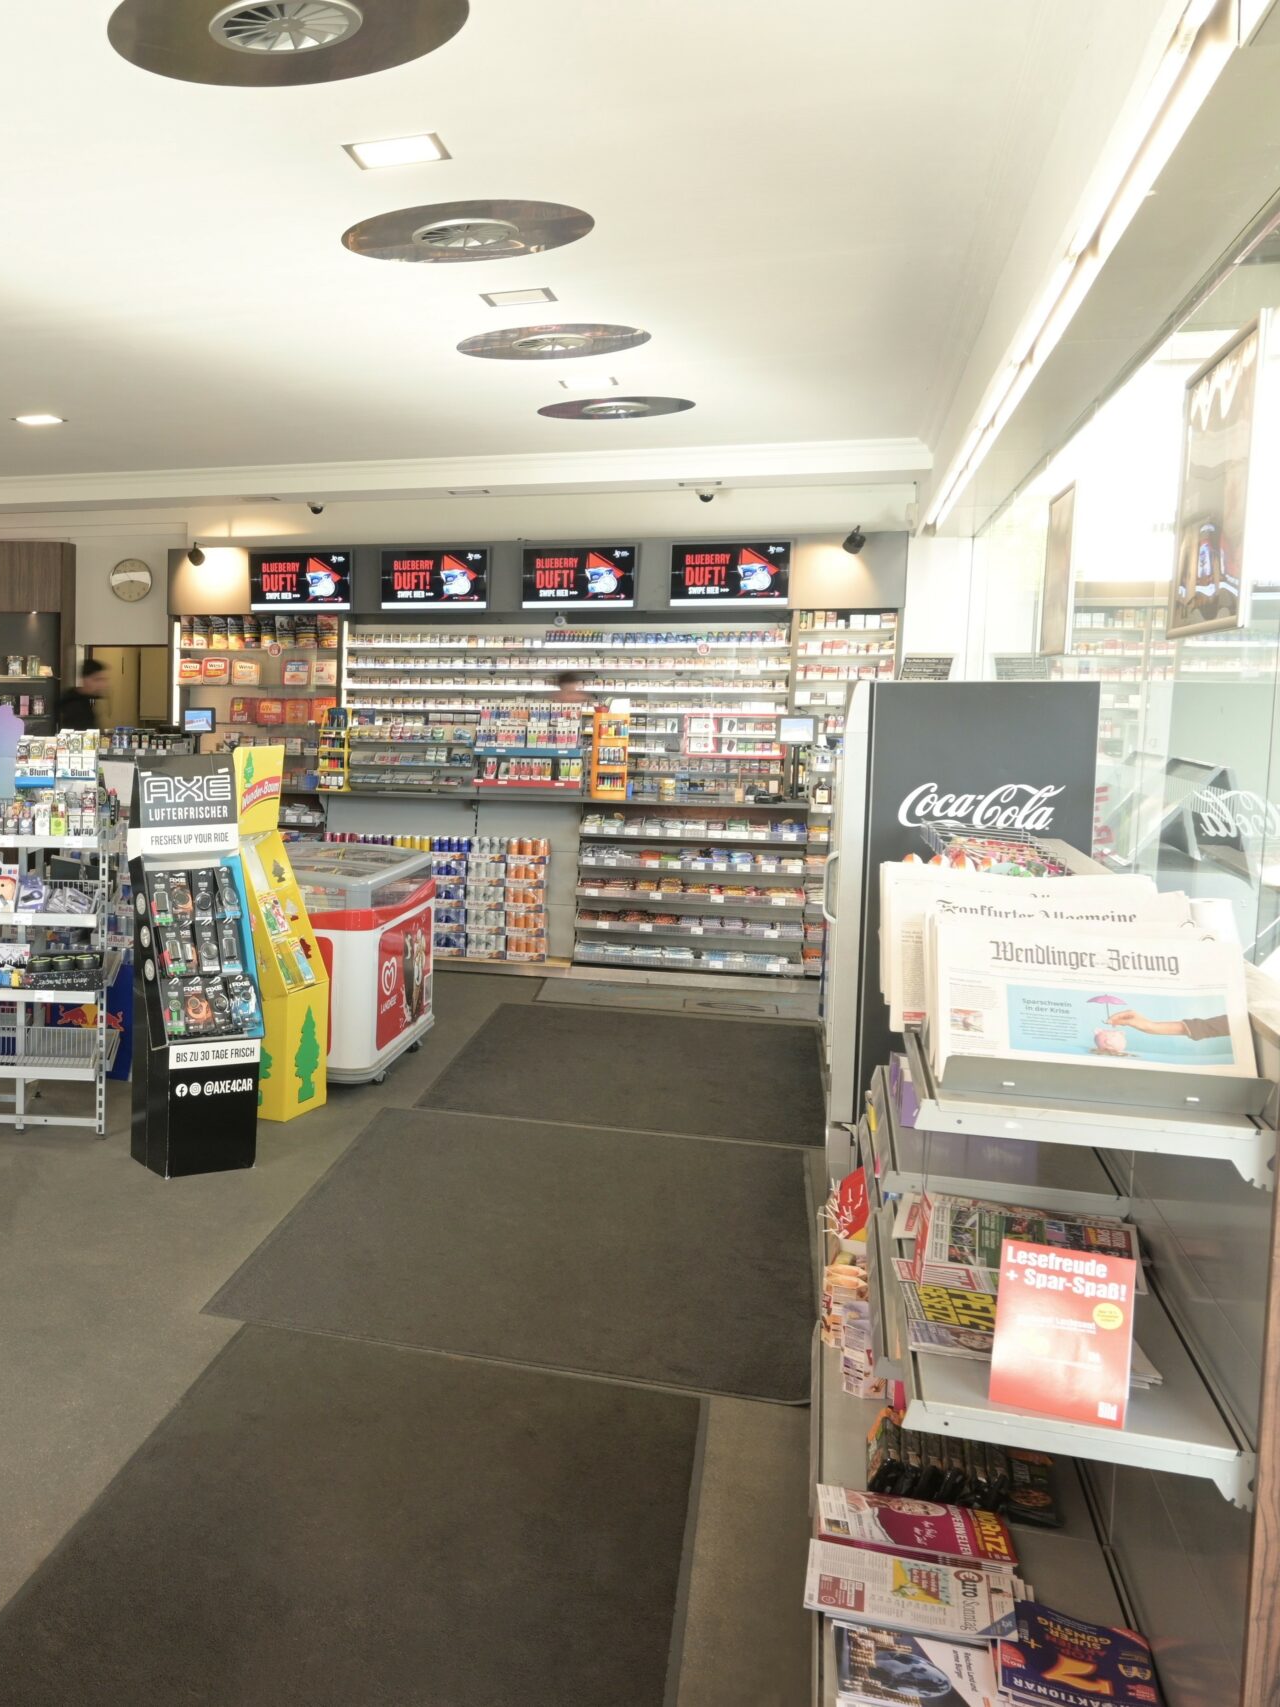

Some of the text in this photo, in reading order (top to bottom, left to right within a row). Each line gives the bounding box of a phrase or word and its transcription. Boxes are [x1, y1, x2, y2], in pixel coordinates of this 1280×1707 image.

[262, 562, 300, 573] BLUEBERRY
[393, 559, 434, 570] BLUEBERRY
[535, 557, 578, 569] BLUEBERRY
[685, 553, 731, 565] BLUEBERRY
[262, 574, 297, 592] DUFT!
[393, 571, 430, 590] DUFT!
[536, 569, 575, 589] DUFT!
[685, 565, 726, 586] DUFT!
[30, 768, 48, 776] Blunt
[148, 805, 228, 822] LUFTERFRISCHER
[898, 782, 1066, 831] Coca-Cola
[74, 828, 94, 836] Wrap
[150, 832, 229, 846] FRESHEN UP YOUR RIDE
[990, 940, 1180, 976] Wendlinger Zeitung
[1021, 998, 1072, 1009] Sparschwein
[1050, 1006, 1070, 1014] Krise
[176, 1047, 255, 1062] BIS ZU 30 TAGE FRISCH
[204, 1078, 253, 1096] @AXE4CAR
[1006, 1246, 1108, 1278] Lesefreude
[1005, 1268, 1127, 1302] + Spar-Spaß!
[960, 1600, 980, 1632] Sonntag
[1042, 1655, 1114, 1696] 7
